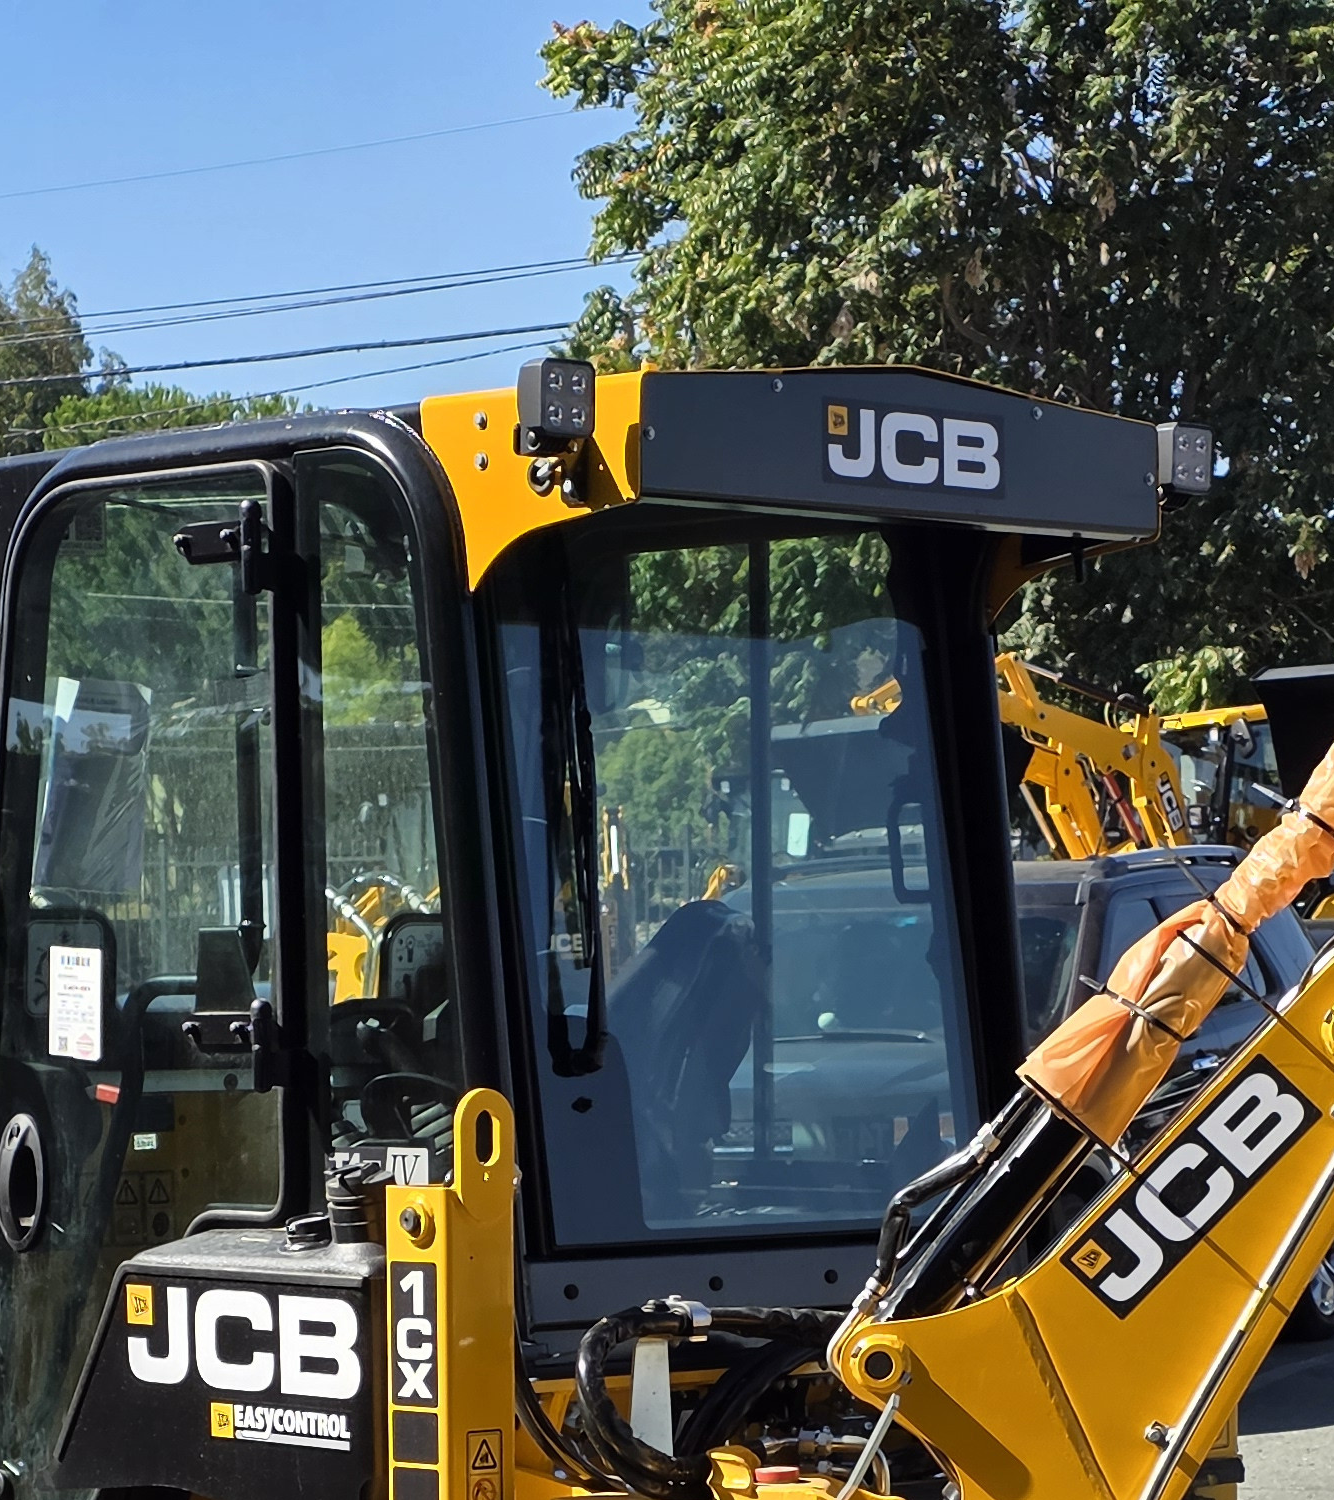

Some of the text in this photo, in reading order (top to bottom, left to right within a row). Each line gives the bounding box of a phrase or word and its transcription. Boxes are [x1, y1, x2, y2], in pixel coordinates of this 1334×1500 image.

[827, 408, 1001, 490] JCB
[1098, 1072, 1305, 1302] JCB
[127, 1286, 361, 1399] JCB
[396, 1270, 433, 1399] 1CX
